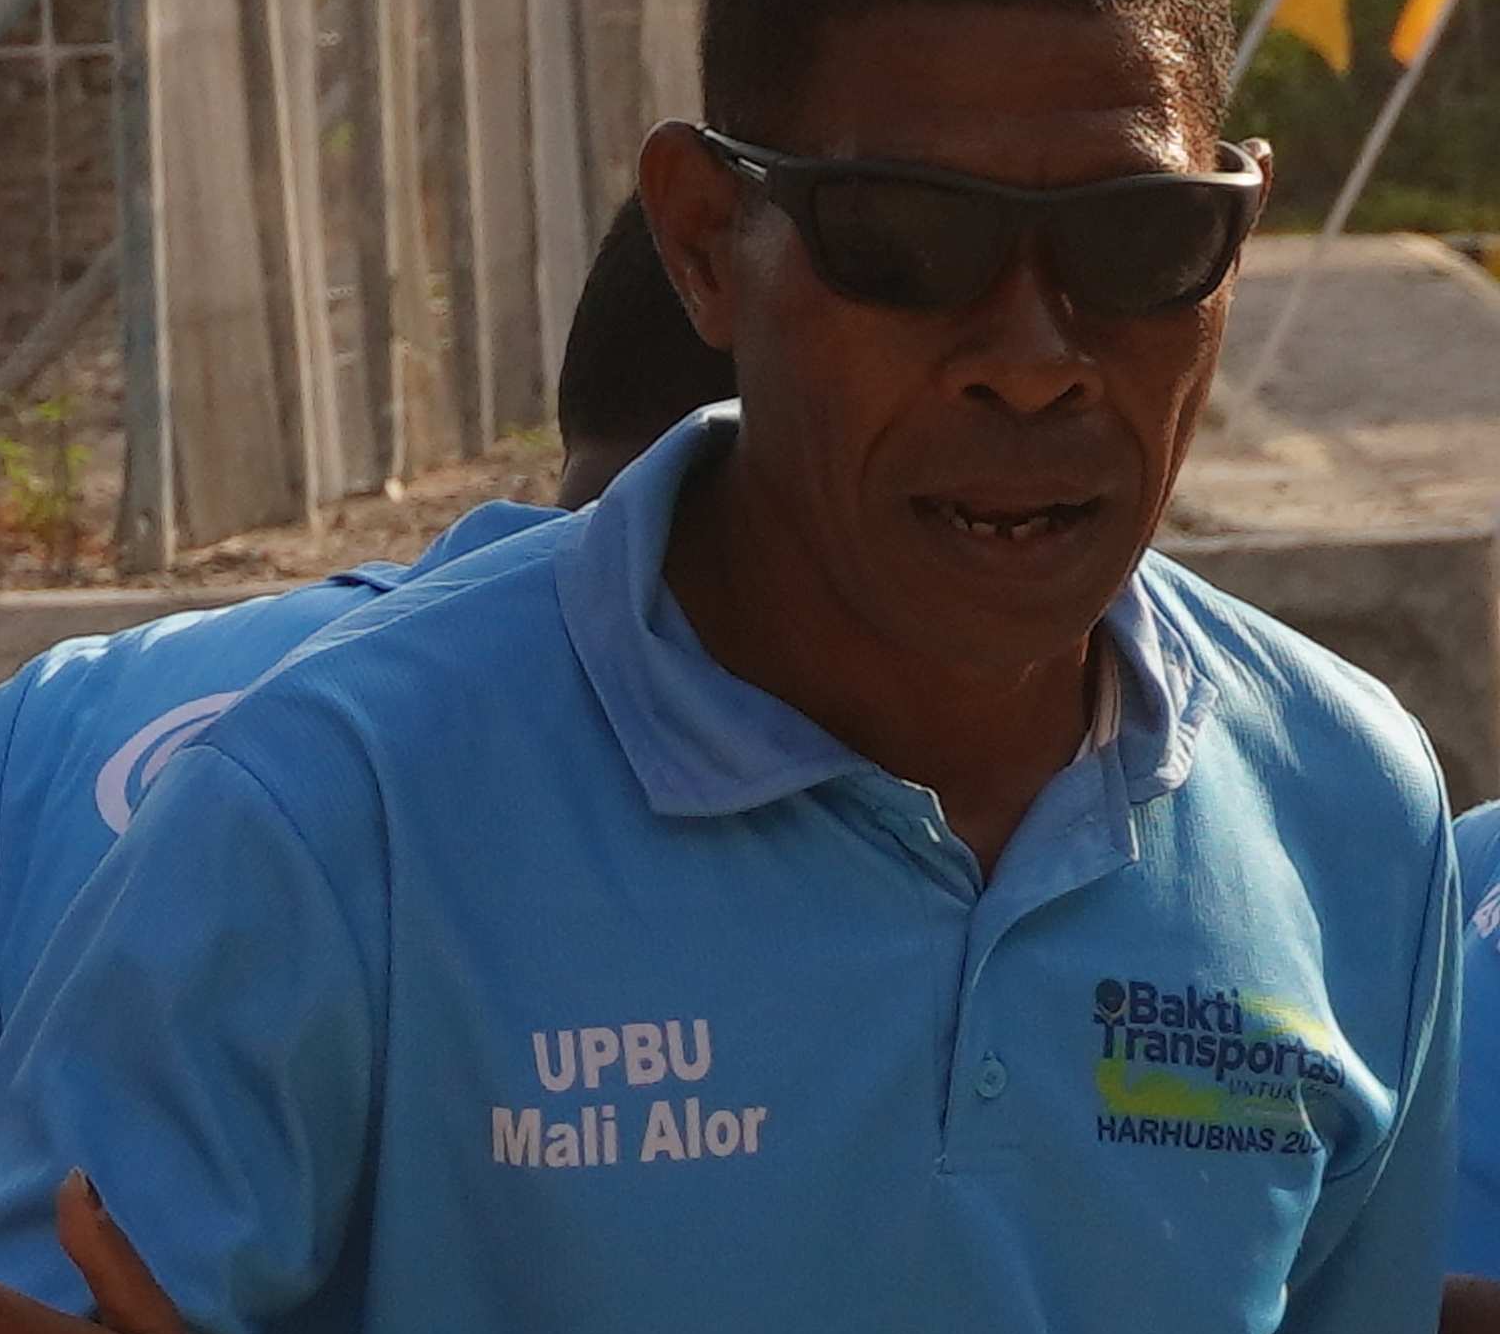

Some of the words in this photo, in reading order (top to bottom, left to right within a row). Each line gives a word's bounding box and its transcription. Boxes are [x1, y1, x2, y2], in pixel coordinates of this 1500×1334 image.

[1128, 981, 1243, 1035] Bakti
[531, 1019, 711, 1091] UPBU
[491, 1104, 618, 1167] Mali
[640, 1097, 767, 1162] Alor
[1096, 1115, 1277, 1153] HARHUBNAS
